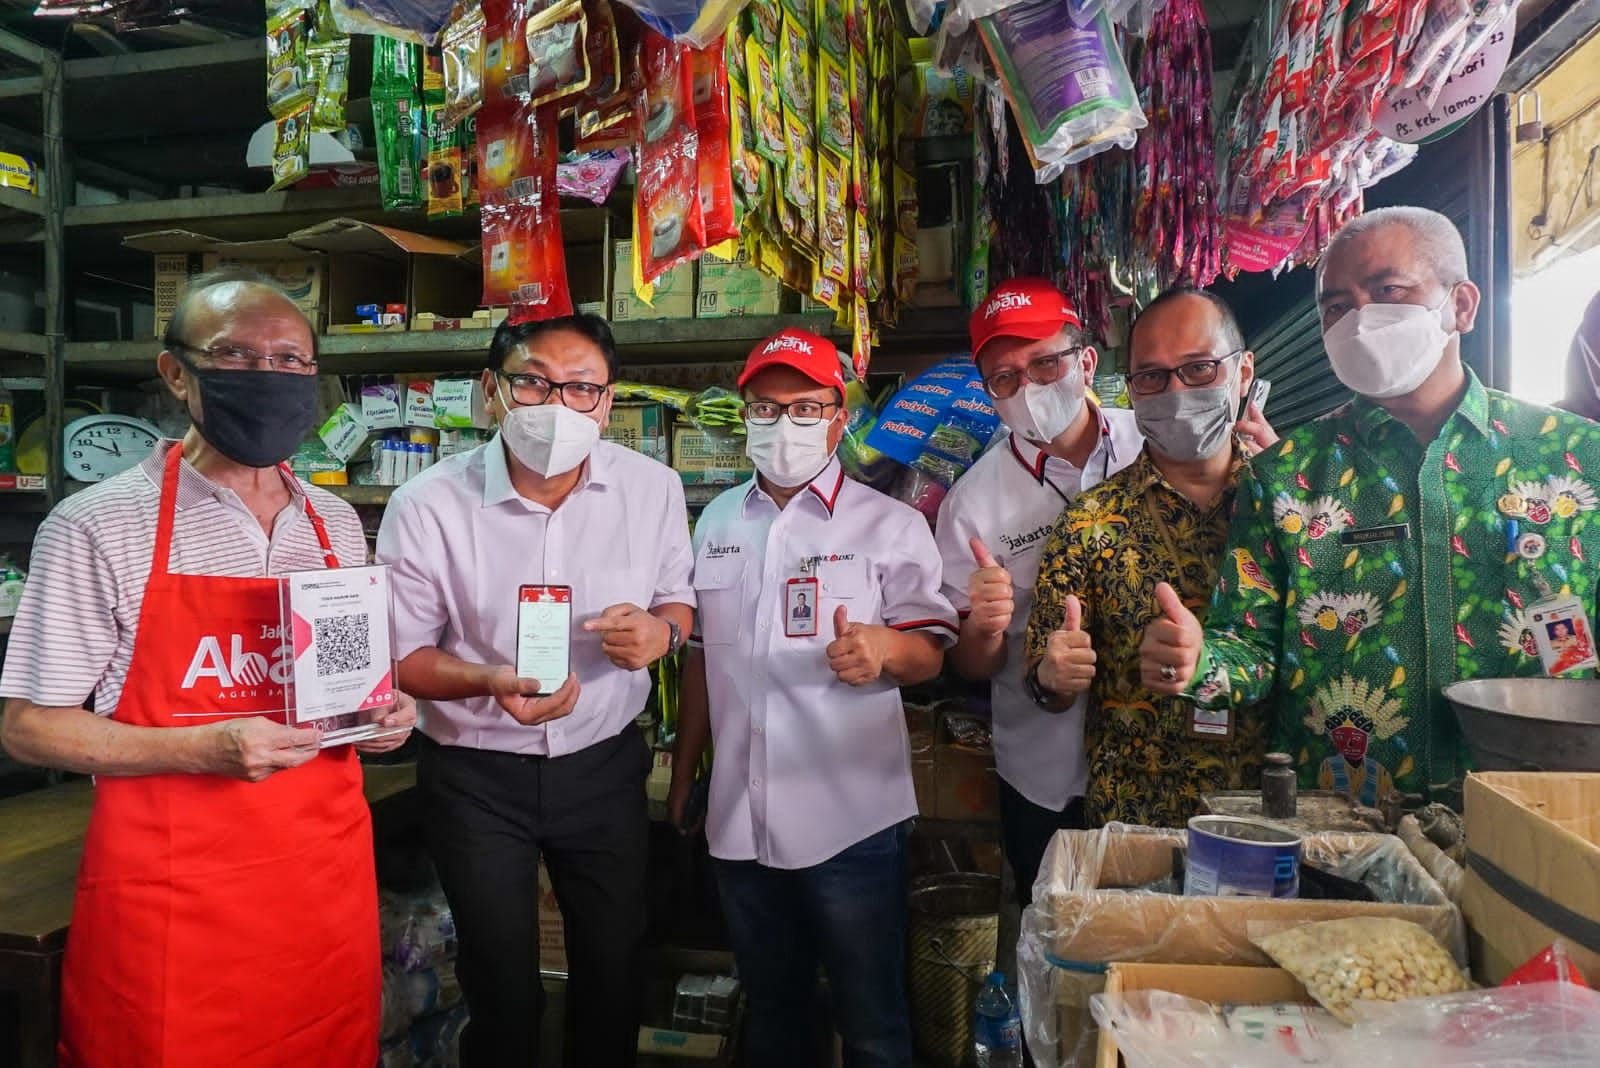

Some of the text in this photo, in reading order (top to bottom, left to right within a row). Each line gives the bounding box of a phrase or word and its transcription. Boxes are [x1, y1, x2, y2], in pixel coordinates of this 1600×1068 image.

[702, 293, 716, 306] 10
[618, 301, 624, 313] 8
[894, 399, 940, 417] Polytex
[952, 398, 996, 417] Polytex
[106, 427, 121, 435] 12
[880, 420, 928, 440] Polytex
[77, 439, 93, 447] 10
[72, 450, 83, 459] 9
[81, 463, 91, 472] 8
[218, 689, 257, 699] AGEN
